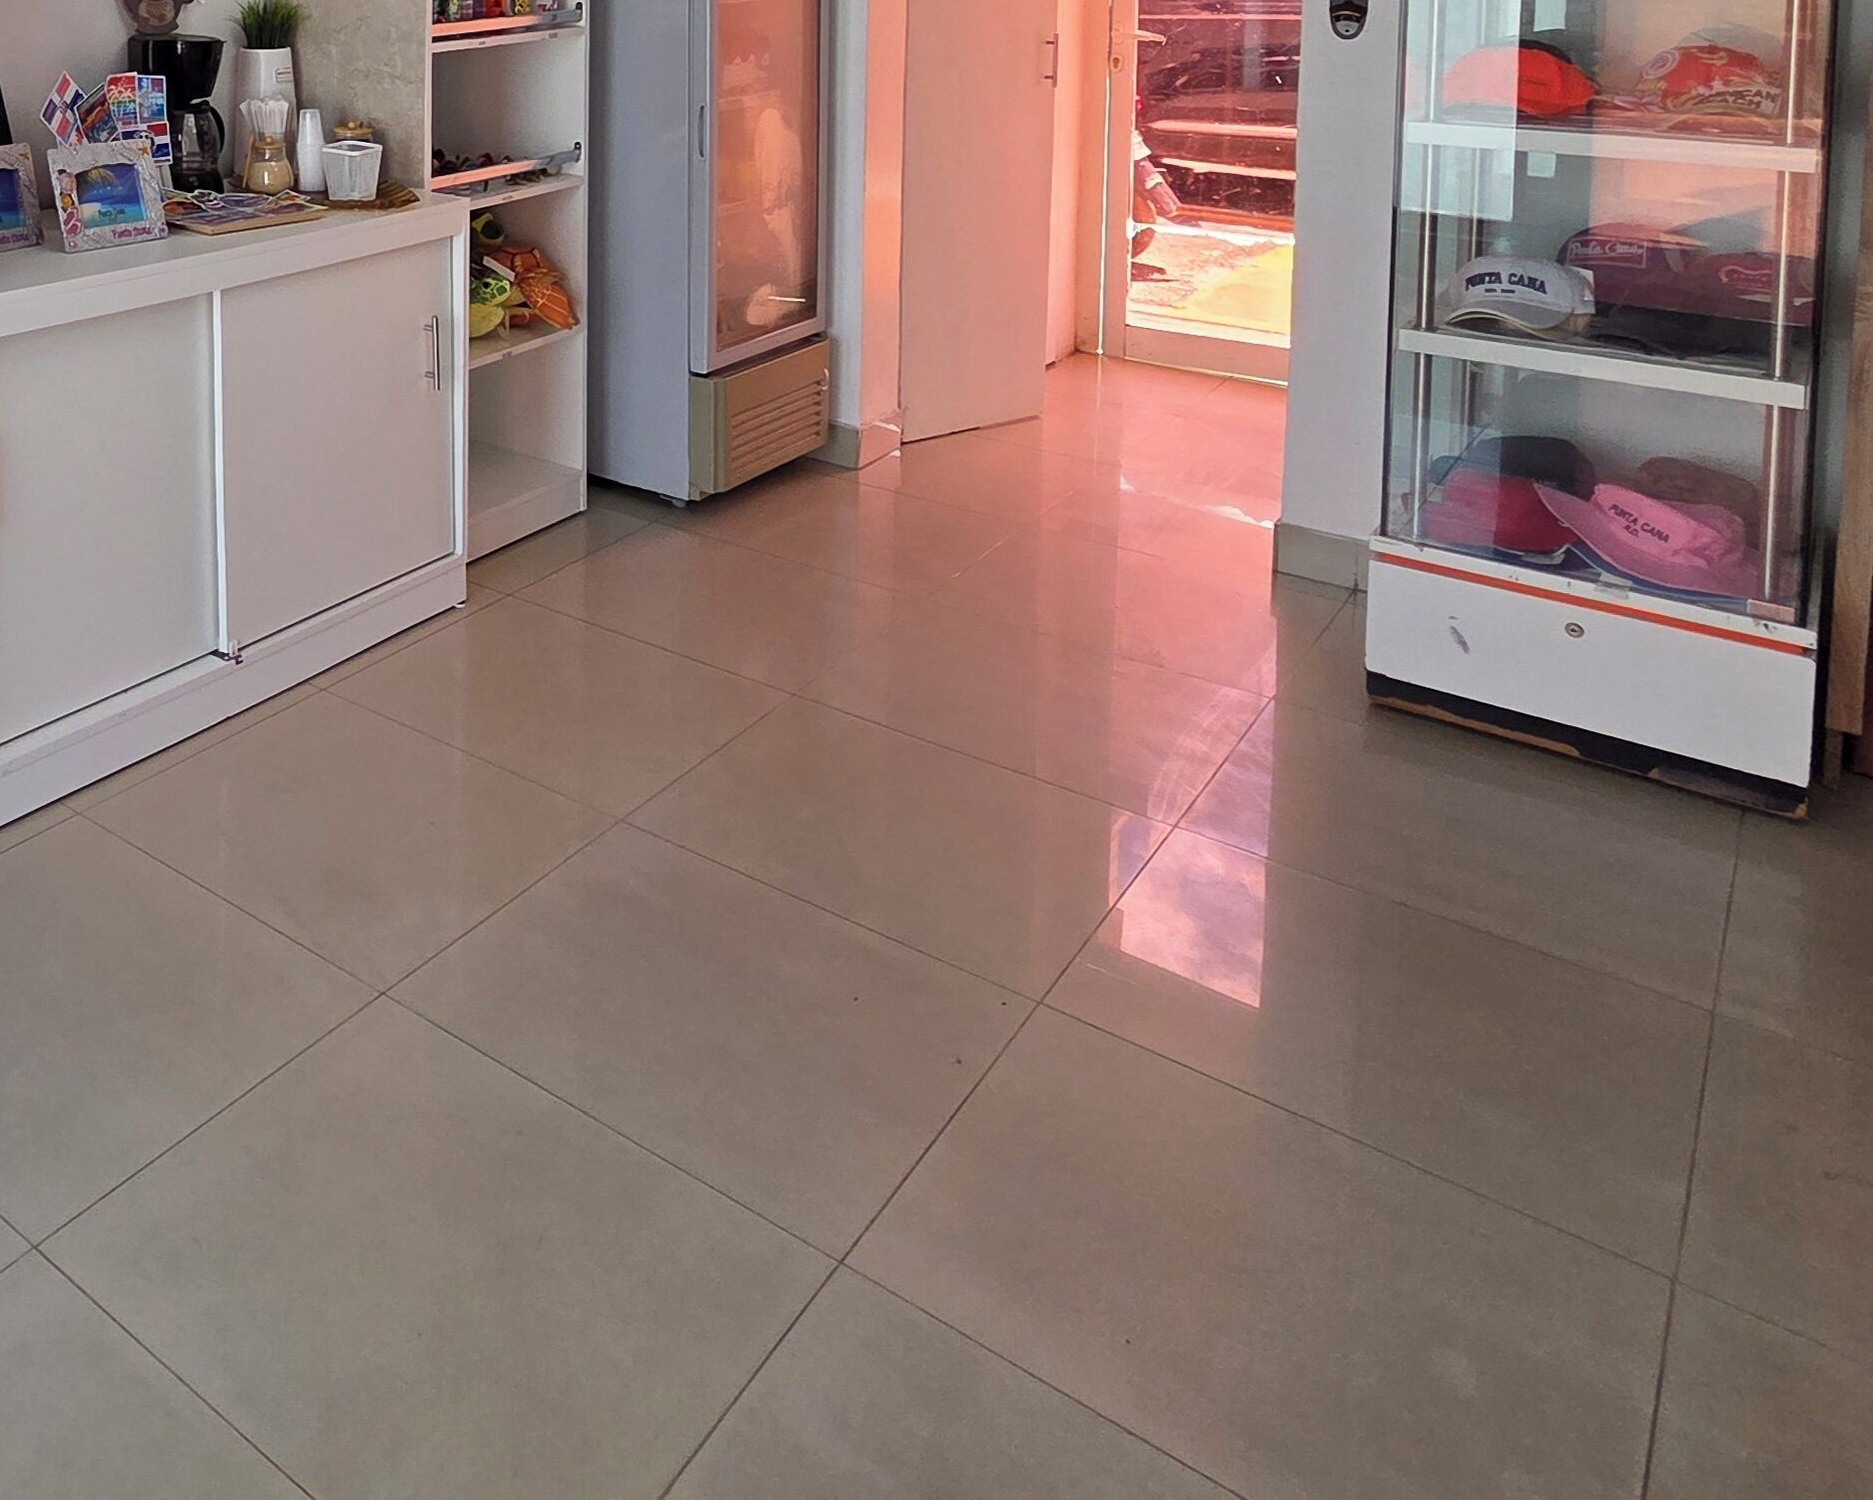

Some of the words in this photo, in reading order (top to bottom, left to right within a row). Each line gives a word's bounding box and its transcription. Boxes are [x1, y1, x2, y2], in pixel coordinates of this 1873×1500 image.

[1464, 271, 1503, 292] PUNTA
[1508, 272, 1548, 295] CANA
[1608, 503, 1639, 526] PUNTA
[1640, 522, 1670, 544] CANA
